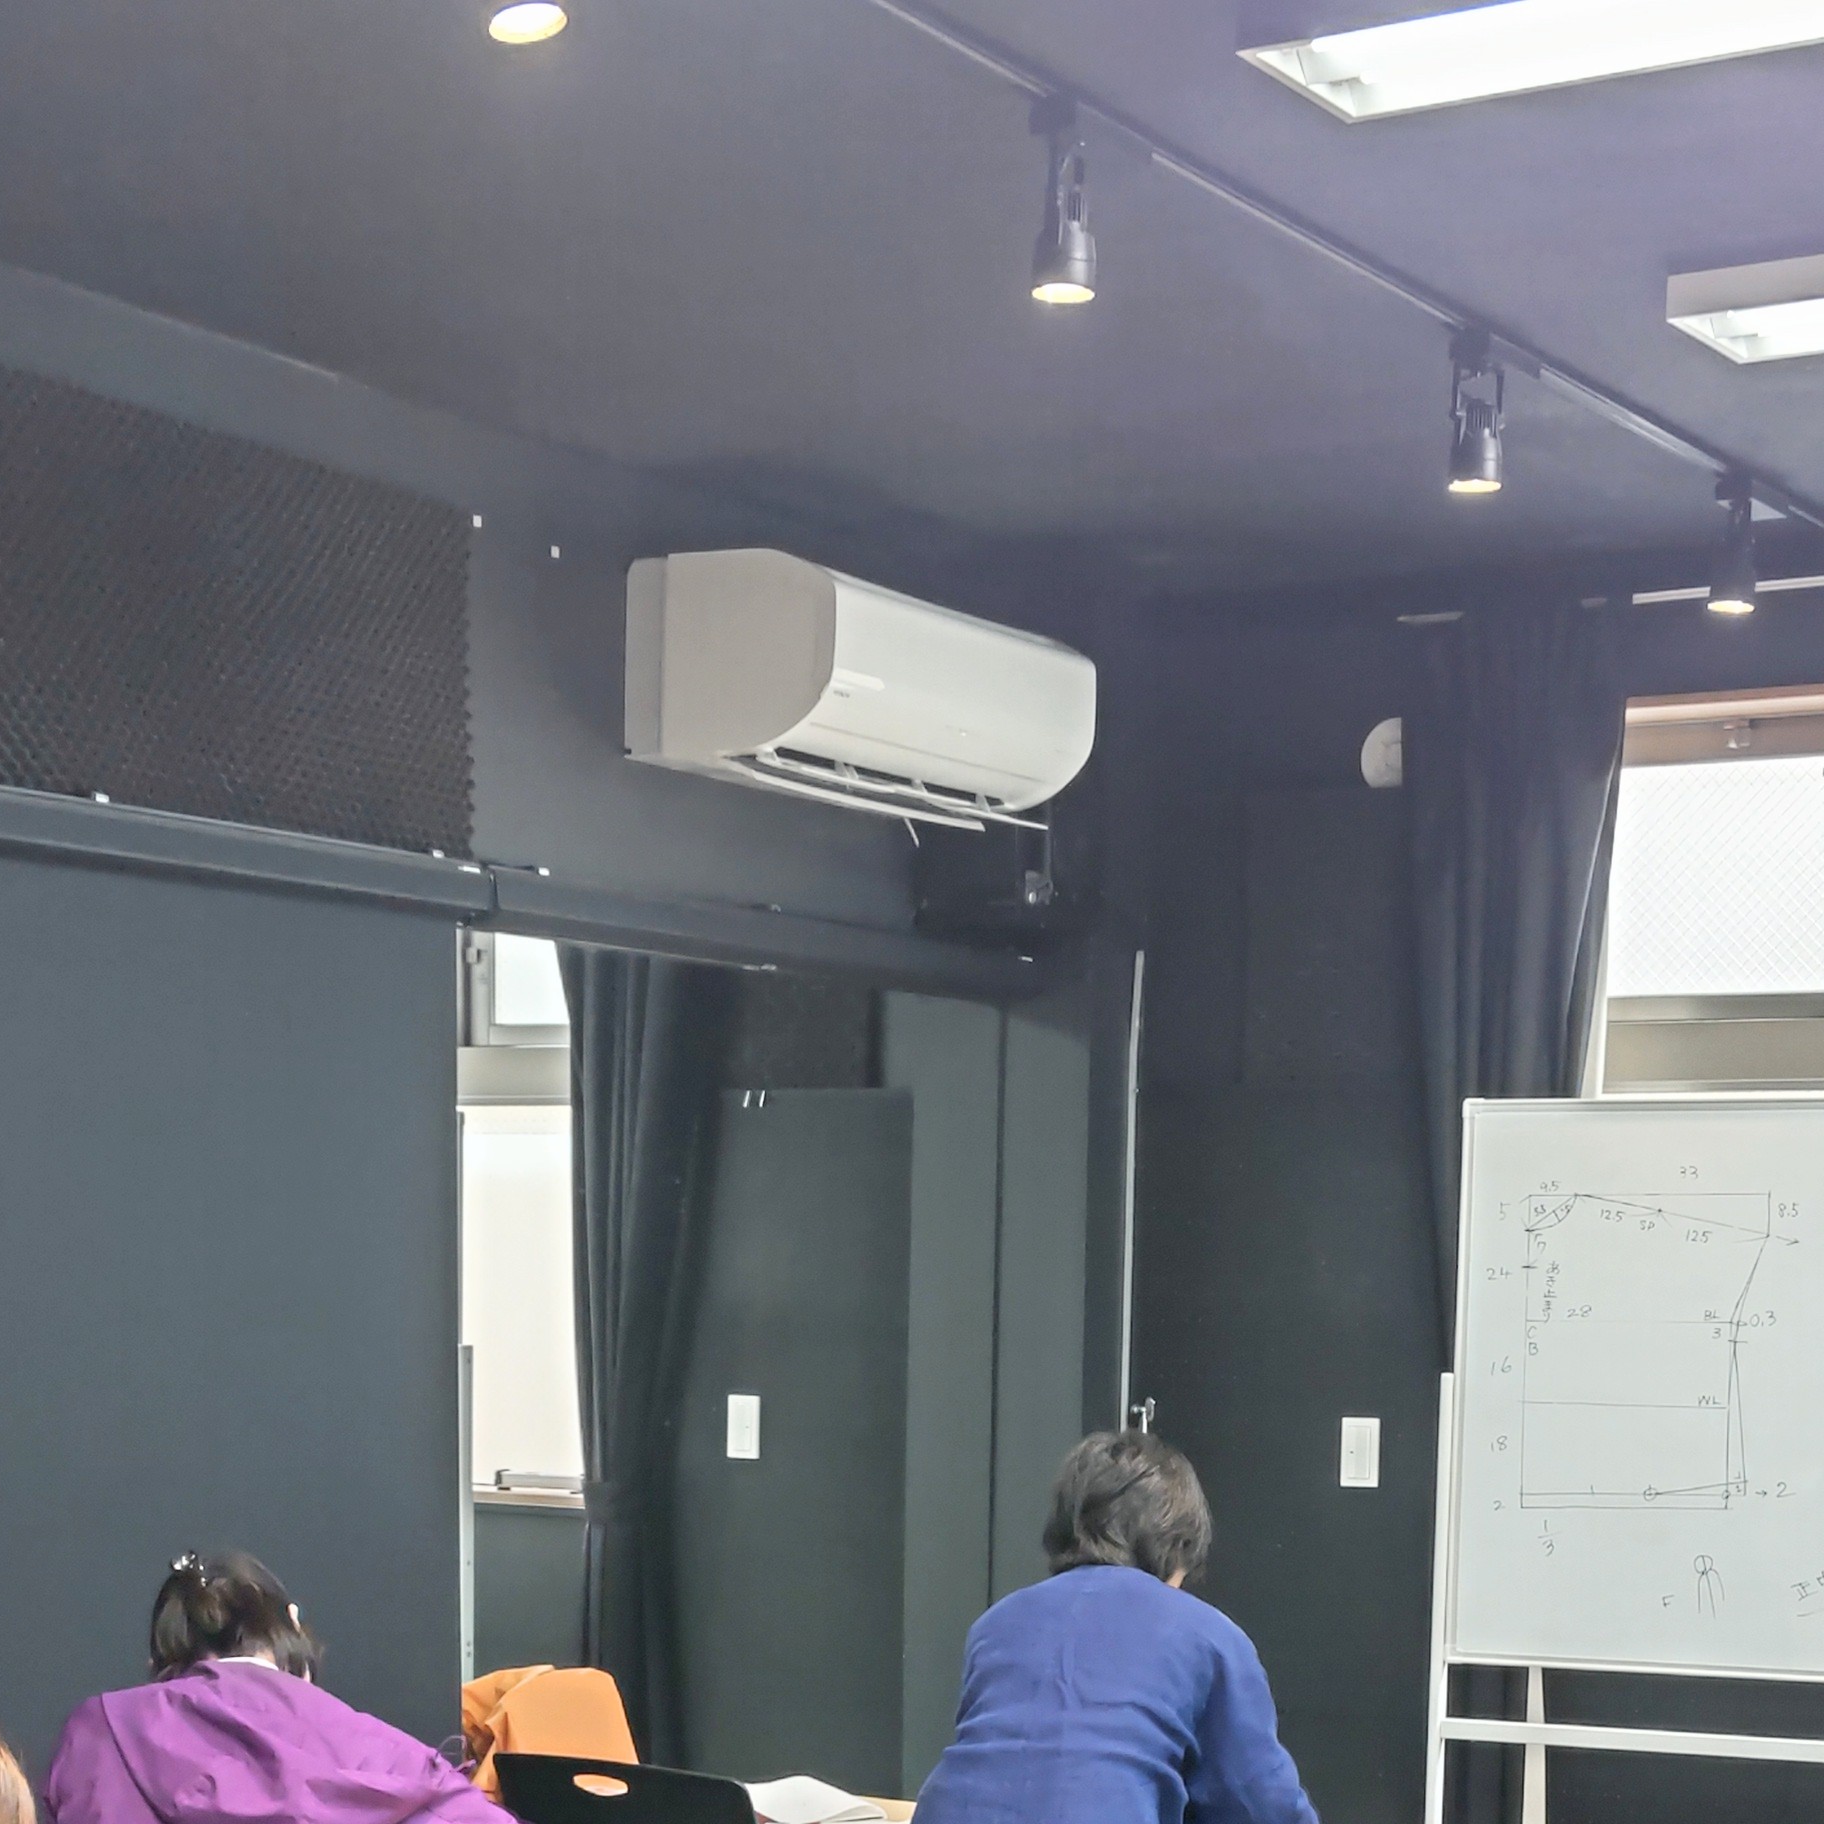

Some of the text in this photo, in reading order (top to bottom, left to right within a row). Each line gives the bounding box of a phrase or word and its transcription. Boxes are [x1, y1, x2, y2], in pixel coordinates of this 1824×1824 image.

[1539, 1180, 1562, 1193] 9.5
[1599, 1208, 1625, 1223] 12.5
[1777, 1202, 1800, 1218] 8.5
[1639, 1219, 1656, 1231] SP
[1485, 1266, 1513, 1281] 24
[1567, 1304, 1593, 1318] 28
[1704, 1309, 1721, 1321] BL
[1748, 1309, 1777, 1328] 0.3
[1711, 1327, 1722, 1340] 3
[1490, 1356, 1513, 1376] 16
[1697, 1394, 1722, 1407] WL
[1490, 1434, 1508, 1452] 18
[1776, 1481, 1797, 1498] 2
[1493, 1500, 1506, 1511] 2
